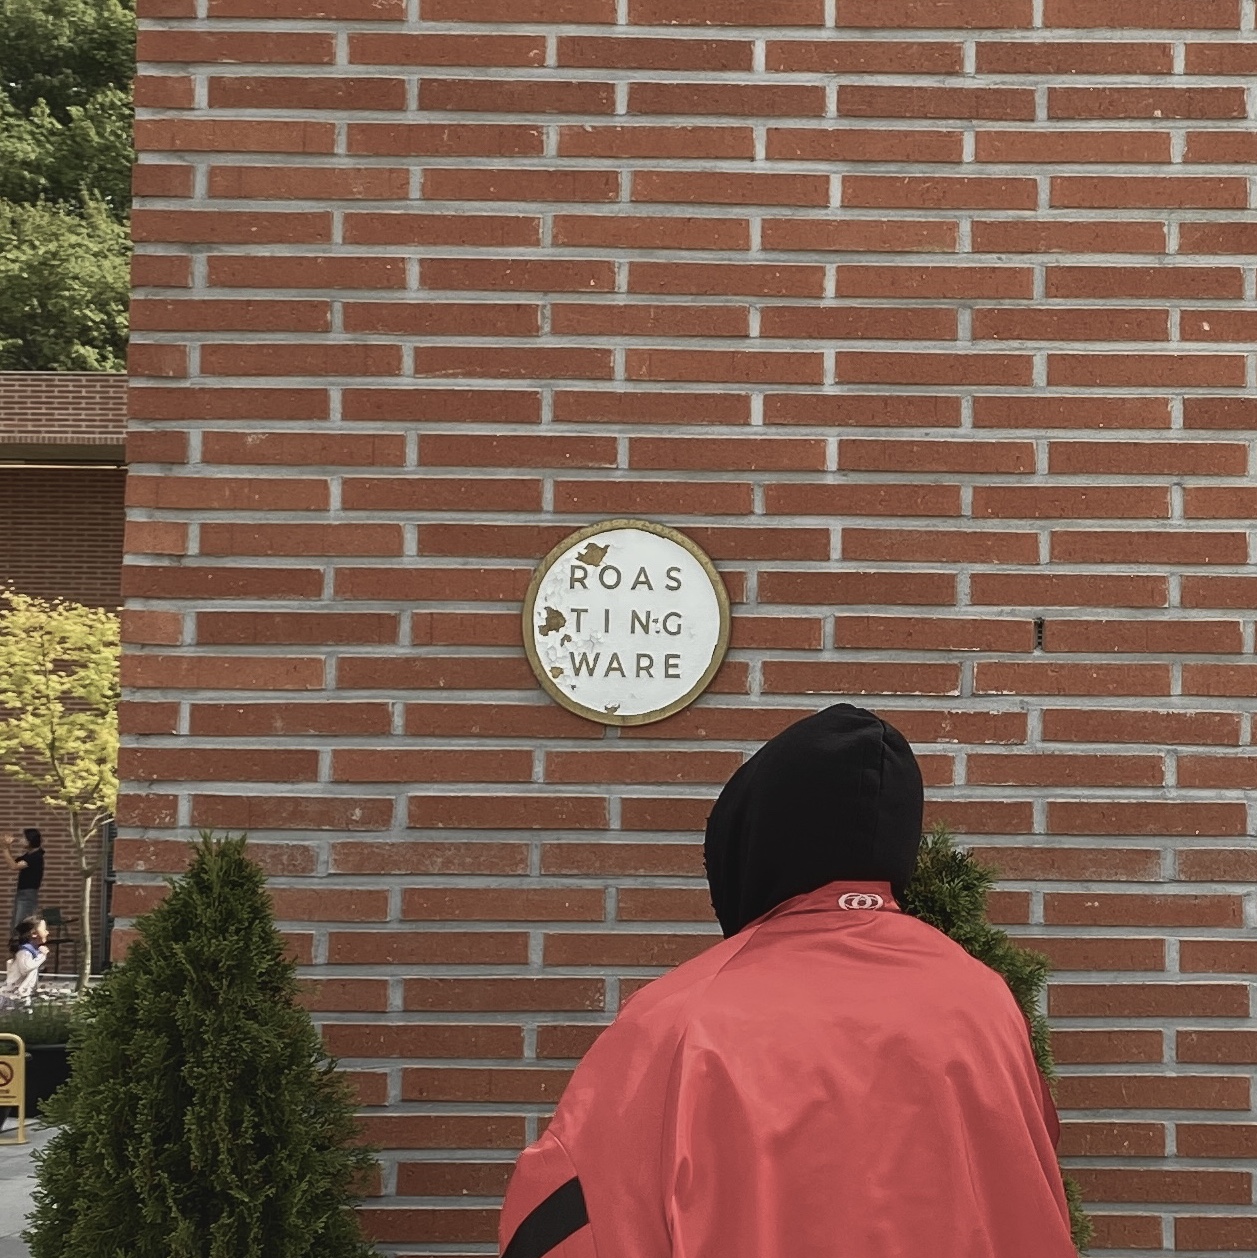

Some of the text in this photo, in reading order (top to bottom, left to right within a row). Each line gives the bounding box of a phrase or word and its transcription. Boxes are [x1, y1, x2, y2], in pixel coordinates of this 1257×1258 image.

[569, 564, 682, 591] ROAS
[570, 608, 682, 636] TING
[569, 652, 681, 679] WARE
